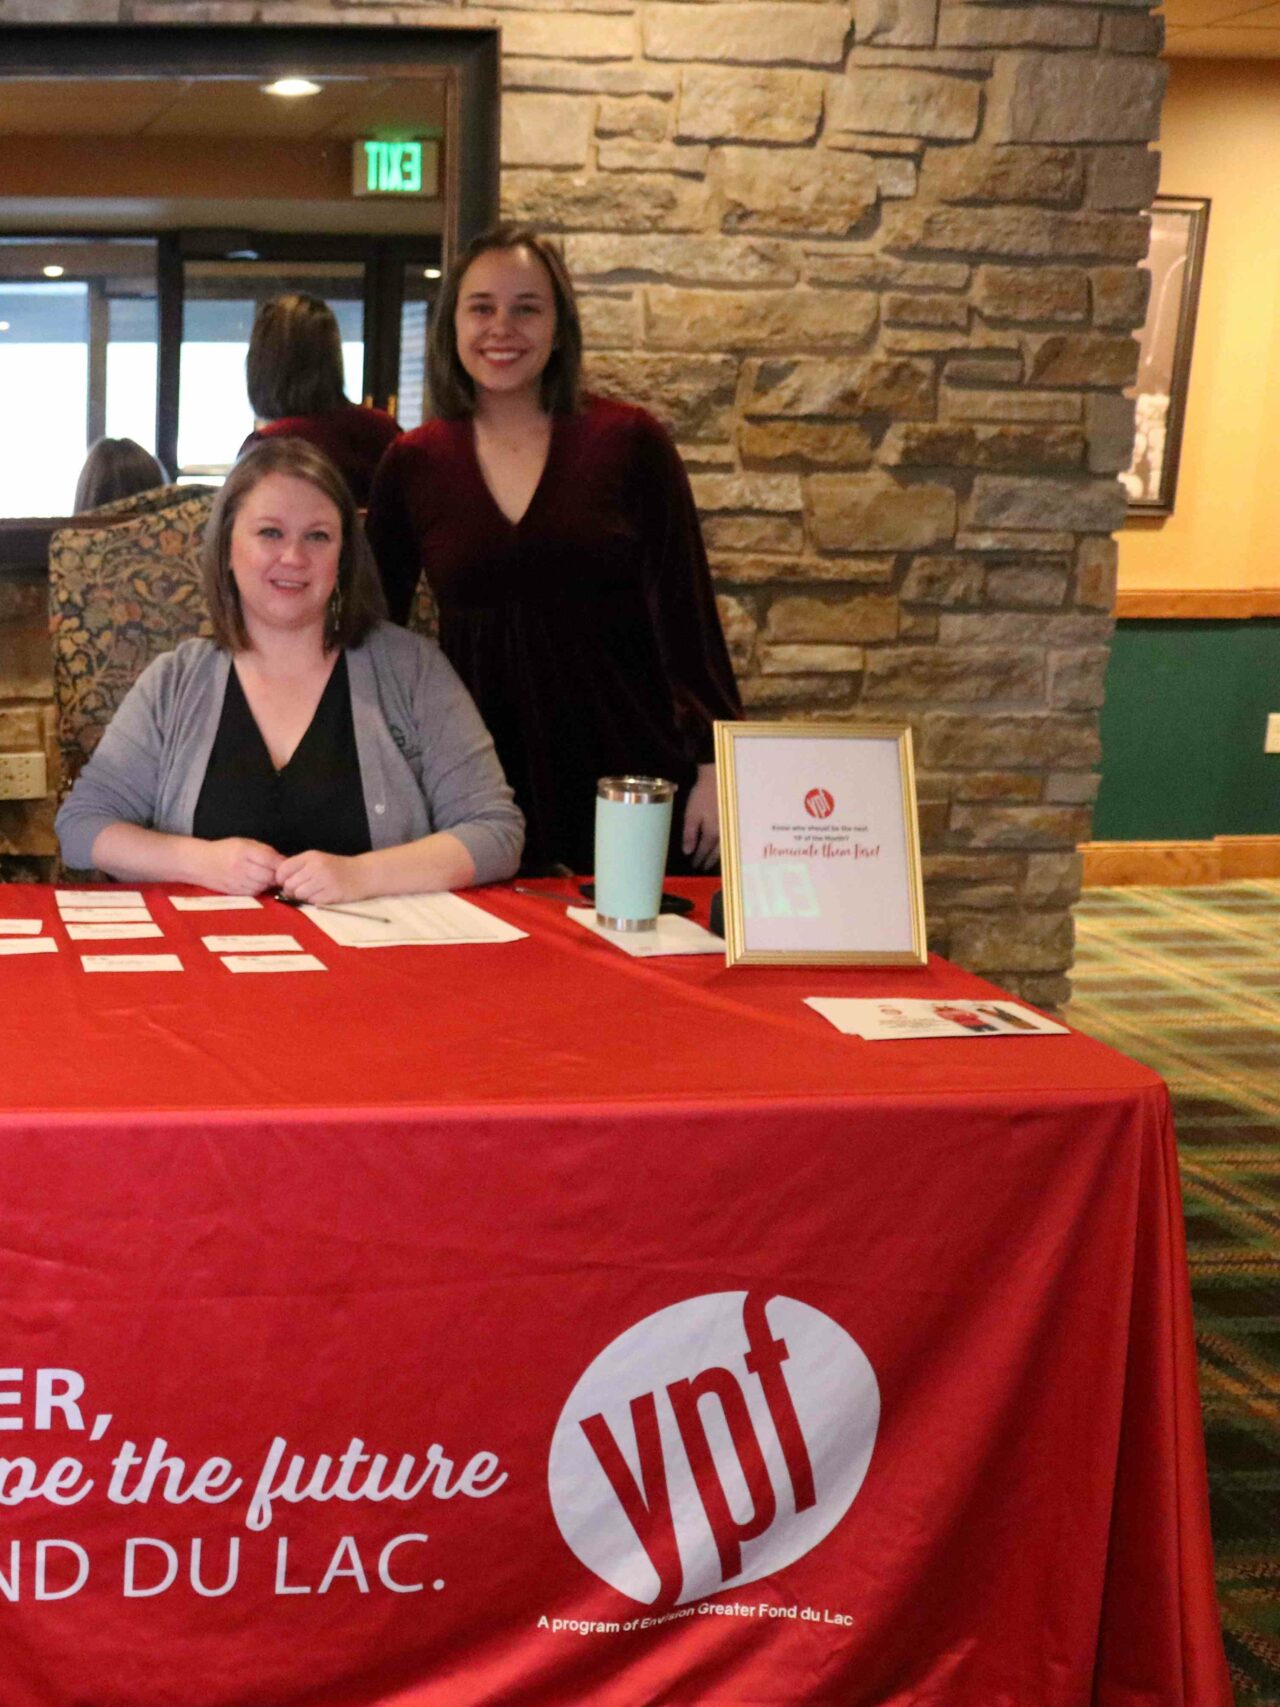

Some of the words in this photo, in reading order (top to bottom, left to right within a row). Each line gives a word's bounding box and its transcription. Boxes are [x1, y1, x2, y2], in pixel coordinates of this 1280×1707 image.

[106, 1436, 243, 1506] the
[244, 1435, 509, 1532] future
[578, 1290, 817, 1606] ypf
[122, 1536, 241, 1599] DU
[274, 1532, 446, 1596] LAC.
[537, 1615, 549, 1628] A
[552, 1617, 620, 1635] program
[622, 1617, 640, 1632] of
[697, 1602, 756, 1617] Greater
[759, 1603, 799, 1619] Fond
[801, 1606, 821, 1621] du
[823, 1609, 854, 1627] Lac
